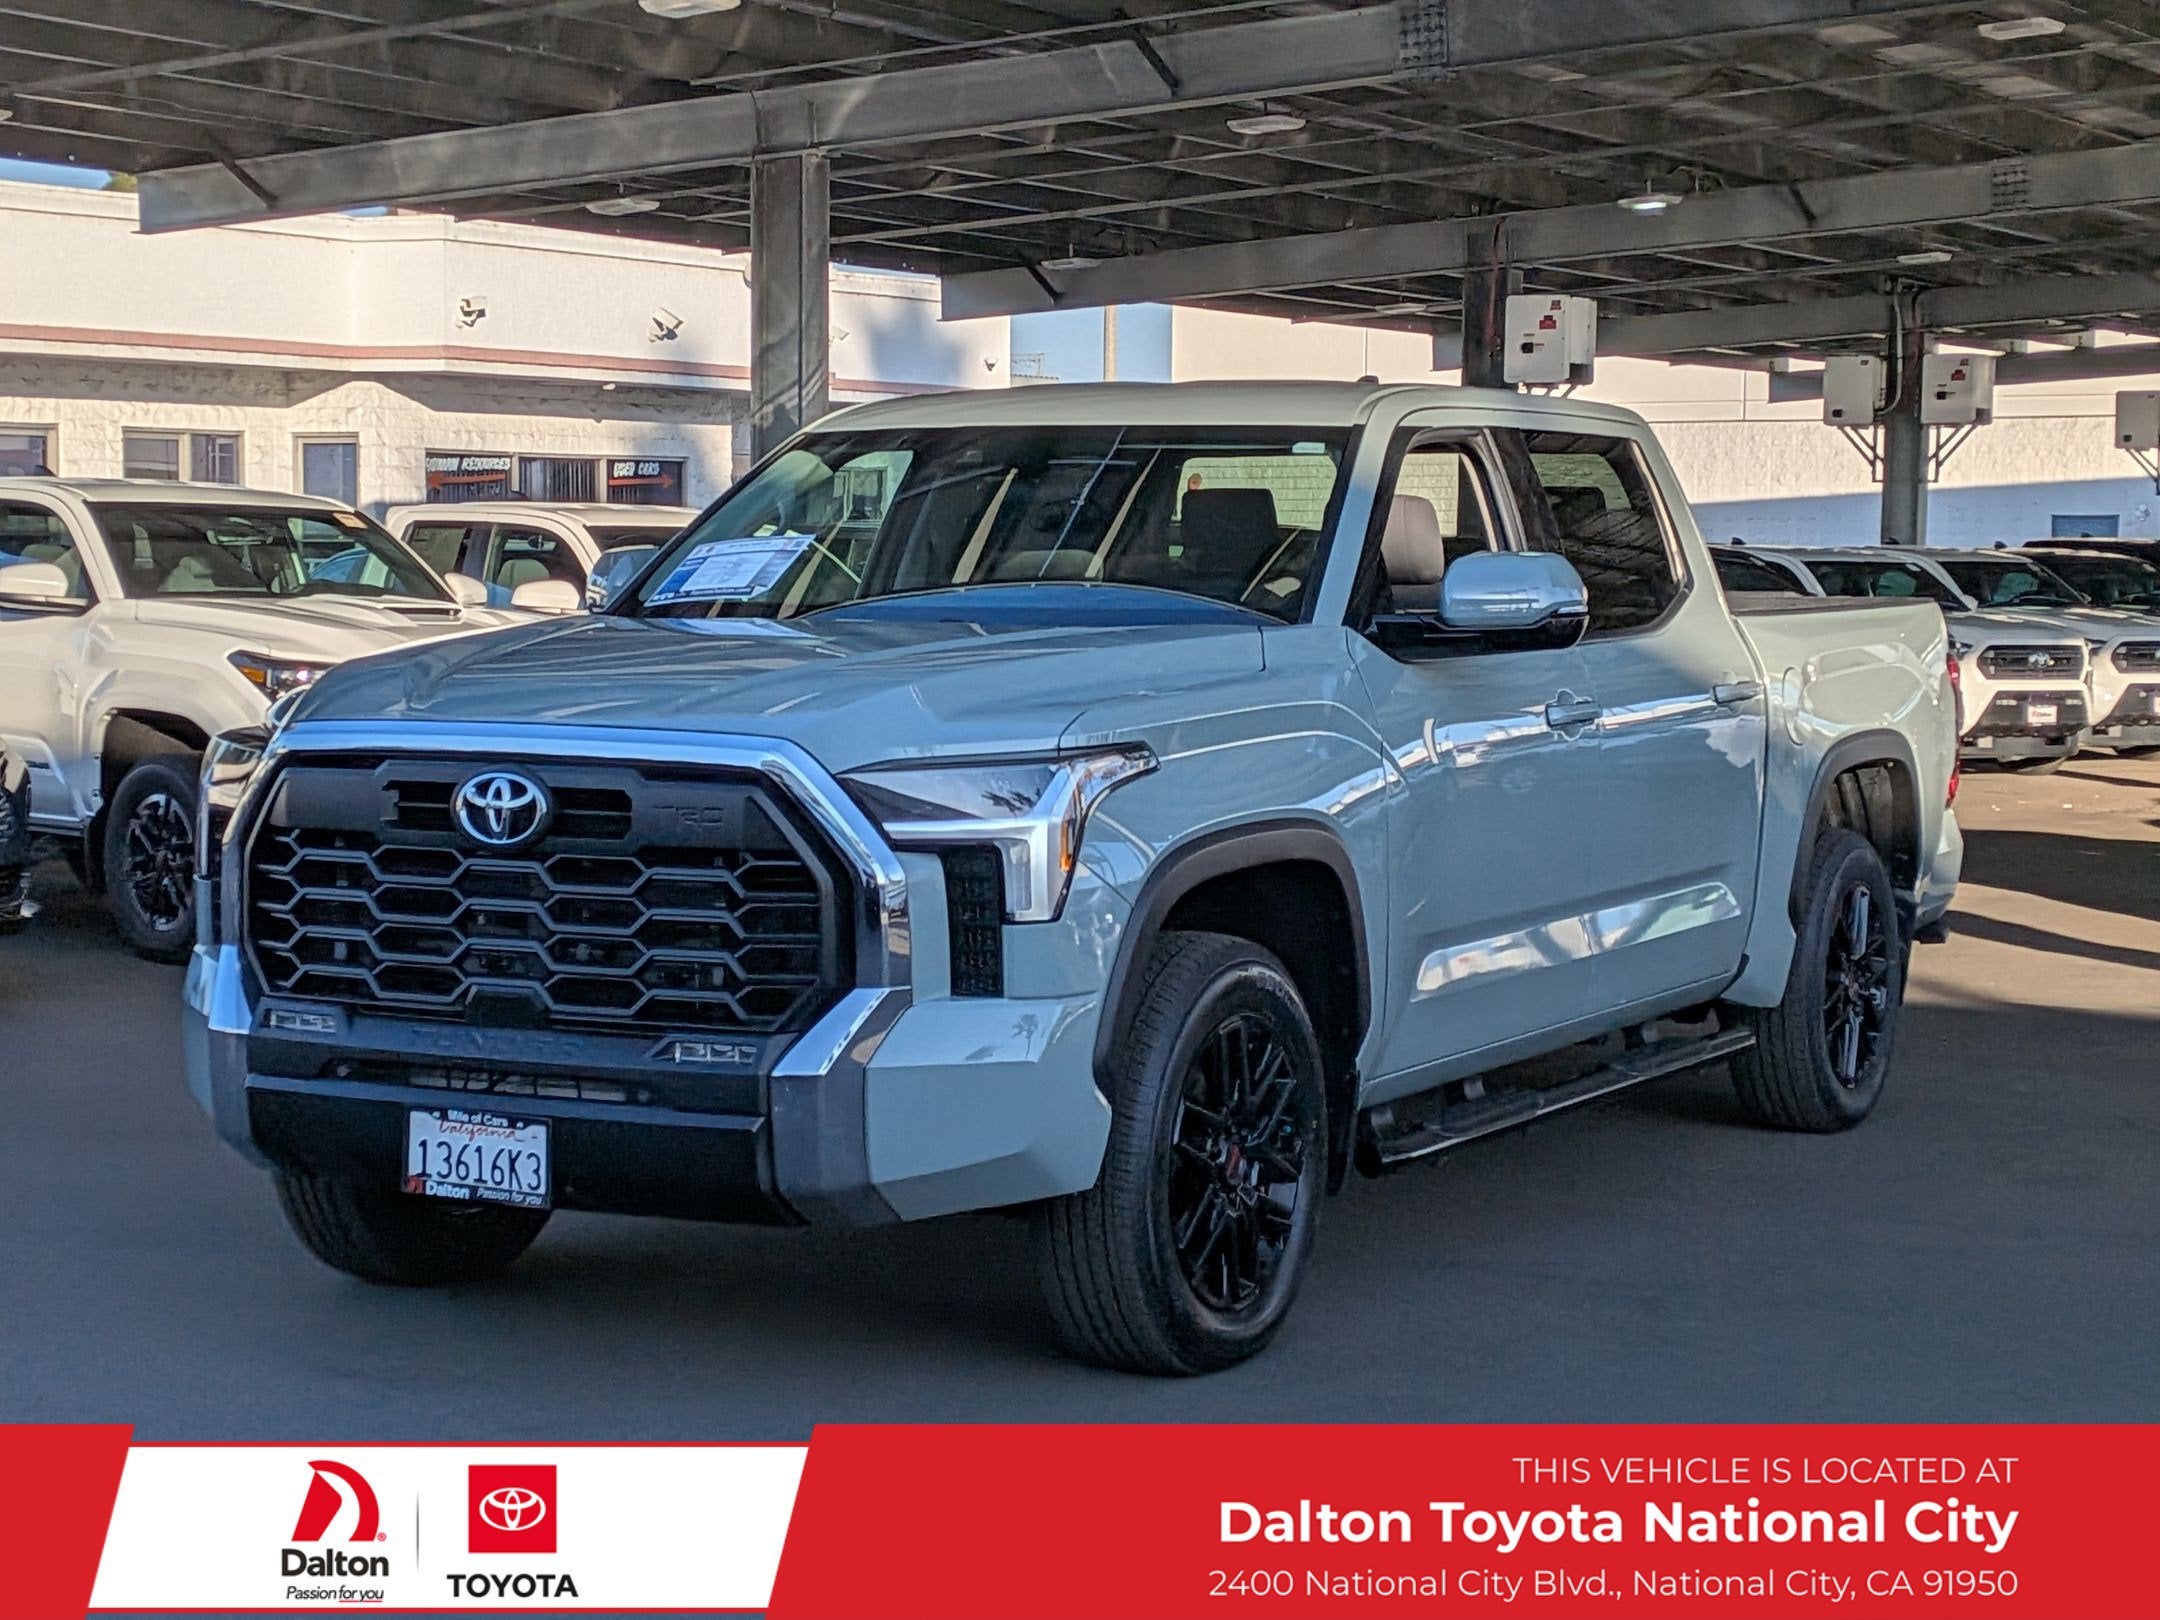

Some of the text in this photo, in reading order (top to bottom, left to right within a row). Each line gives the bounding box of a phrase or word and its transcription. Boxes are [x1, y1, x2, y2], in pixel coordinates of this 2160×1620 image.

[613, 462, 660, 477] USED CARS
[470, 1111, 482, 1124] of
[483, 1114, 509, 1128] Cars
[439, 1119, 525, 1142] California
[416, 1138, 542, 1191] 13616K3
[425, 1180, 471, 1199] Dalton
